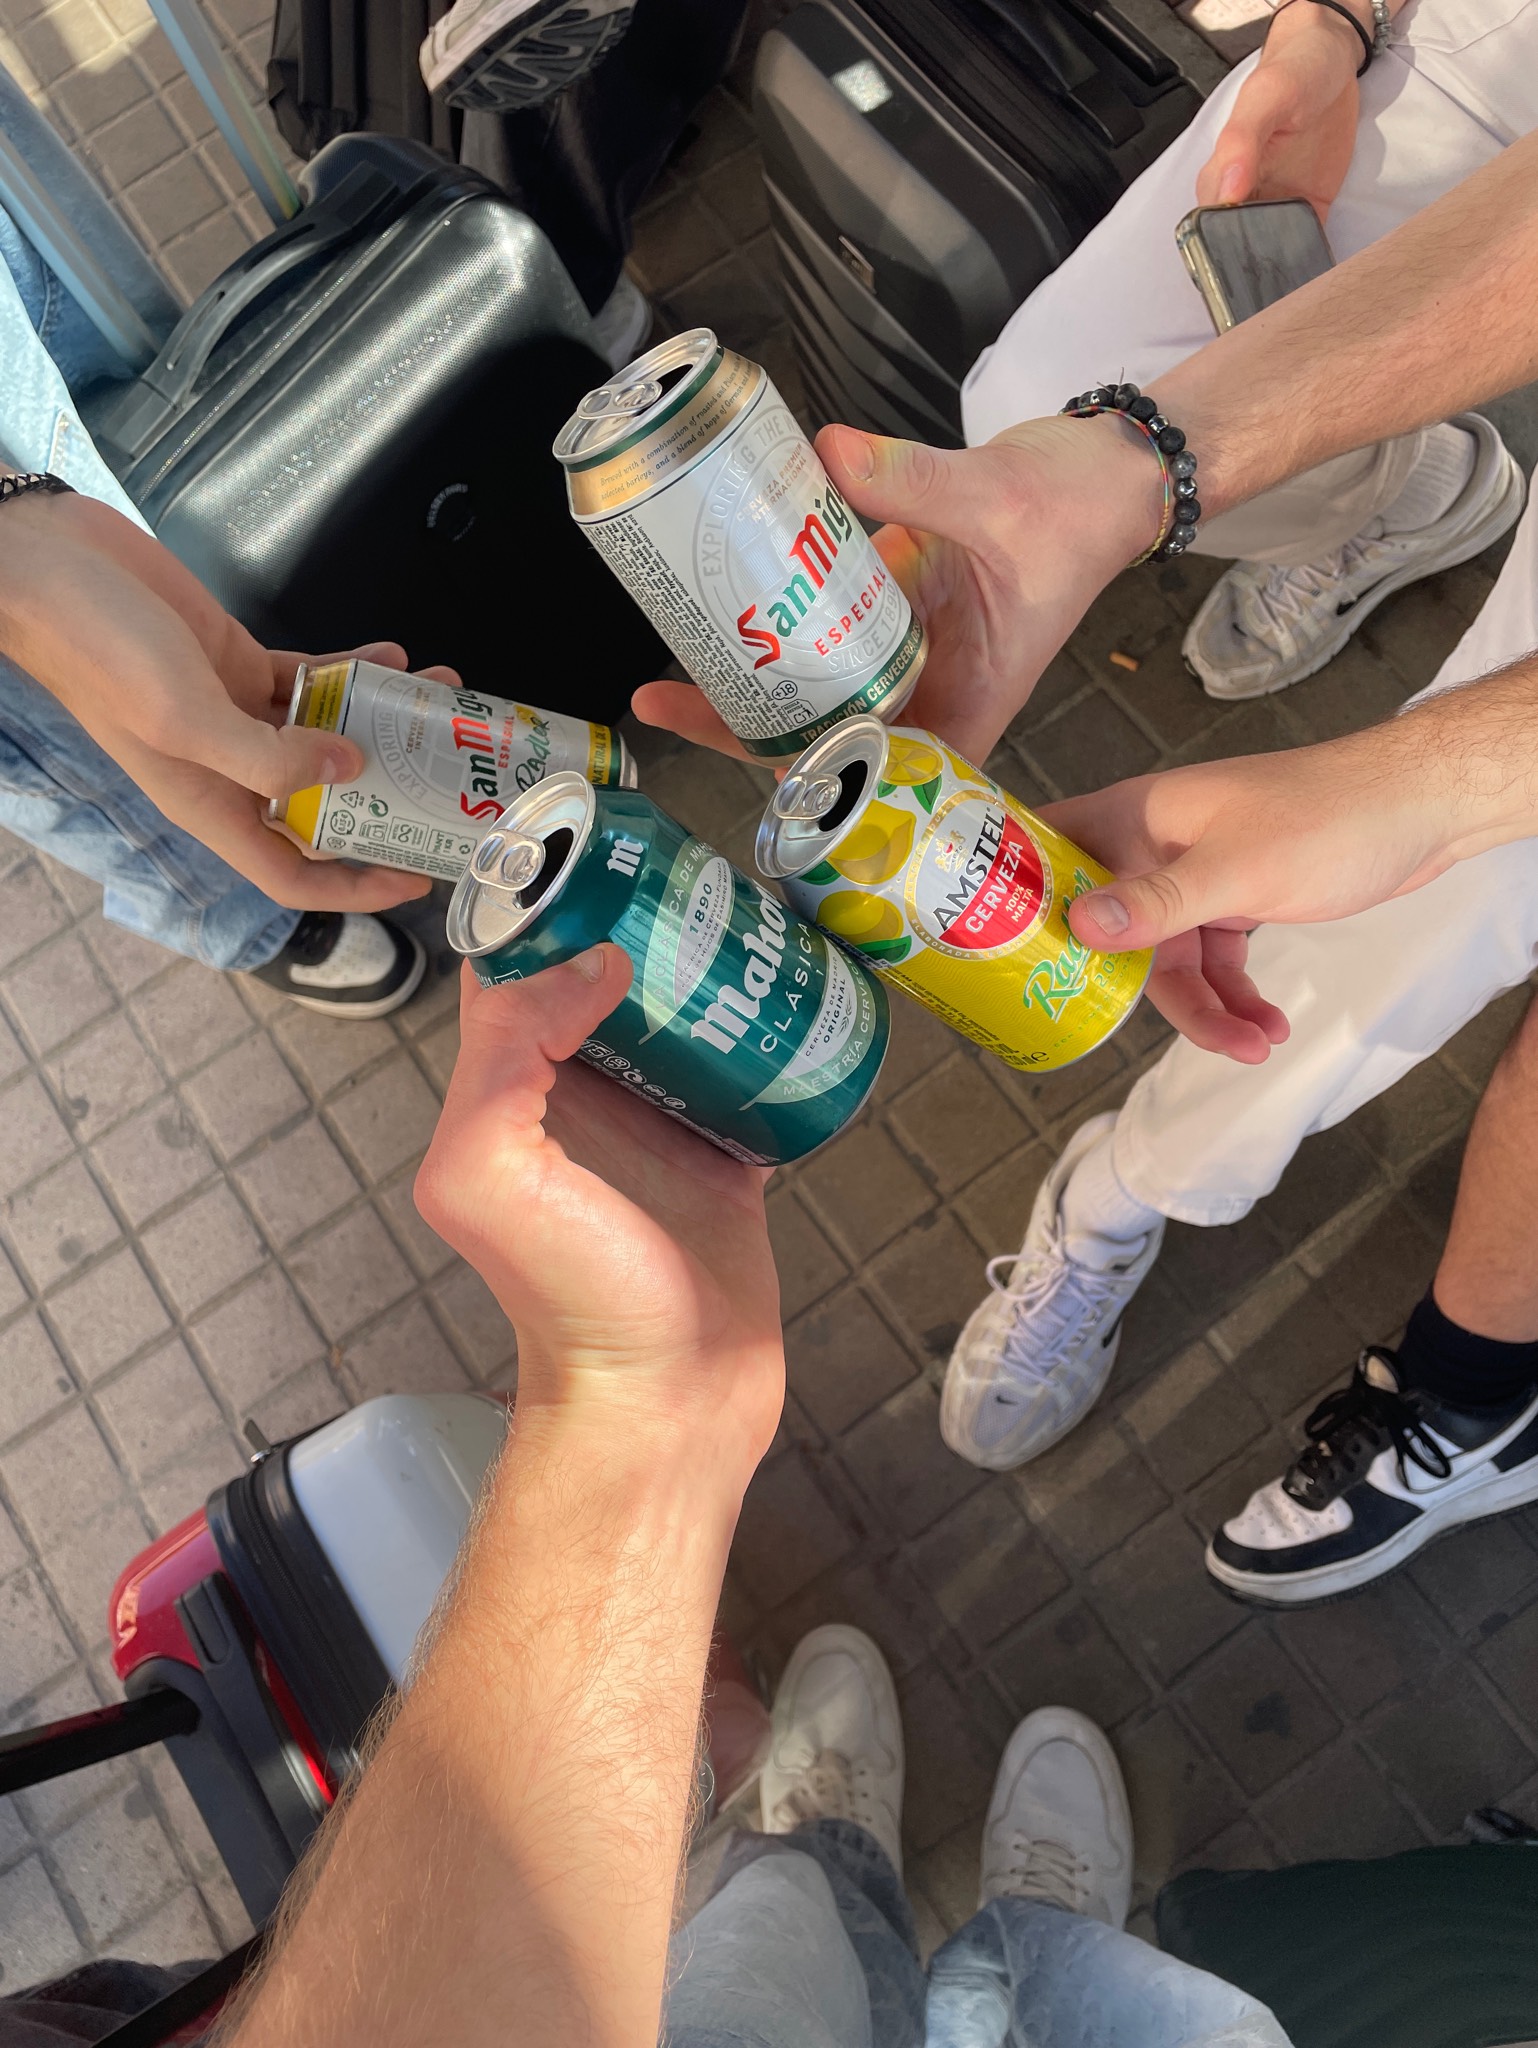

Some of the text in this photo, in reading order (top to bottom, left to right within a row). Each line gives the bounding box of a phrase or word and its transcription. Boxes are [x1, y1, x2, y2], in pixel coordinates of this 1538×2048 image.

[624, 461, 640, 475] with
[646, 425, 689, 460] combination
[697, 397, 718, 419] roasted
[655, 456, 670, 470] and
[677, 435, 697, 455] blend
[705, 412, 721, 431] hops
[702, 415, 784, 577] EXPLORING THE
[752, 457, 807, 524] NTERNACIONAL
[737, 475, 853, 670] San Mig
[814, 566, 887, 656] ESPECIAL
[828, 581, 898, 673] SINCE 1890
[774, 683, 796, 698] +18
[866, 641, 918, 701] CERVECERA
[379, 712, 429, 800] EXPLORING
[450, 687, 506, 822] San Migu
[498, 715, 515, 768] ESPECIAL
[592, 741, 607, 785] NATURAL
[432, 831, 442, 854] PANT
[932, 812, 1006, 932] AMSTEL
[655, 888, 685, 977] CLÁSCA
[679, 859, 695, 883] DE
[689, 841, 714, 861] MAHO
[689, 882, 712, 936] 1890
[706, 893, 720, 930] CERVEZA
[965, 840, 1025, 934] CERVEZA
[1005, 884, 1026, 913] 100%
[1011, 887, 1035, 923] MALTA
[911, 917, 971, 960] ELABORADA
[759, 922, 812, 1053] CLÁSICA
[805, 956, 839, 1057] CERVEZA DE MADRID
[823, 978, 847, 1044] ORIGINAL
[783, 1040, 864, 1096] MAESTRÍA
